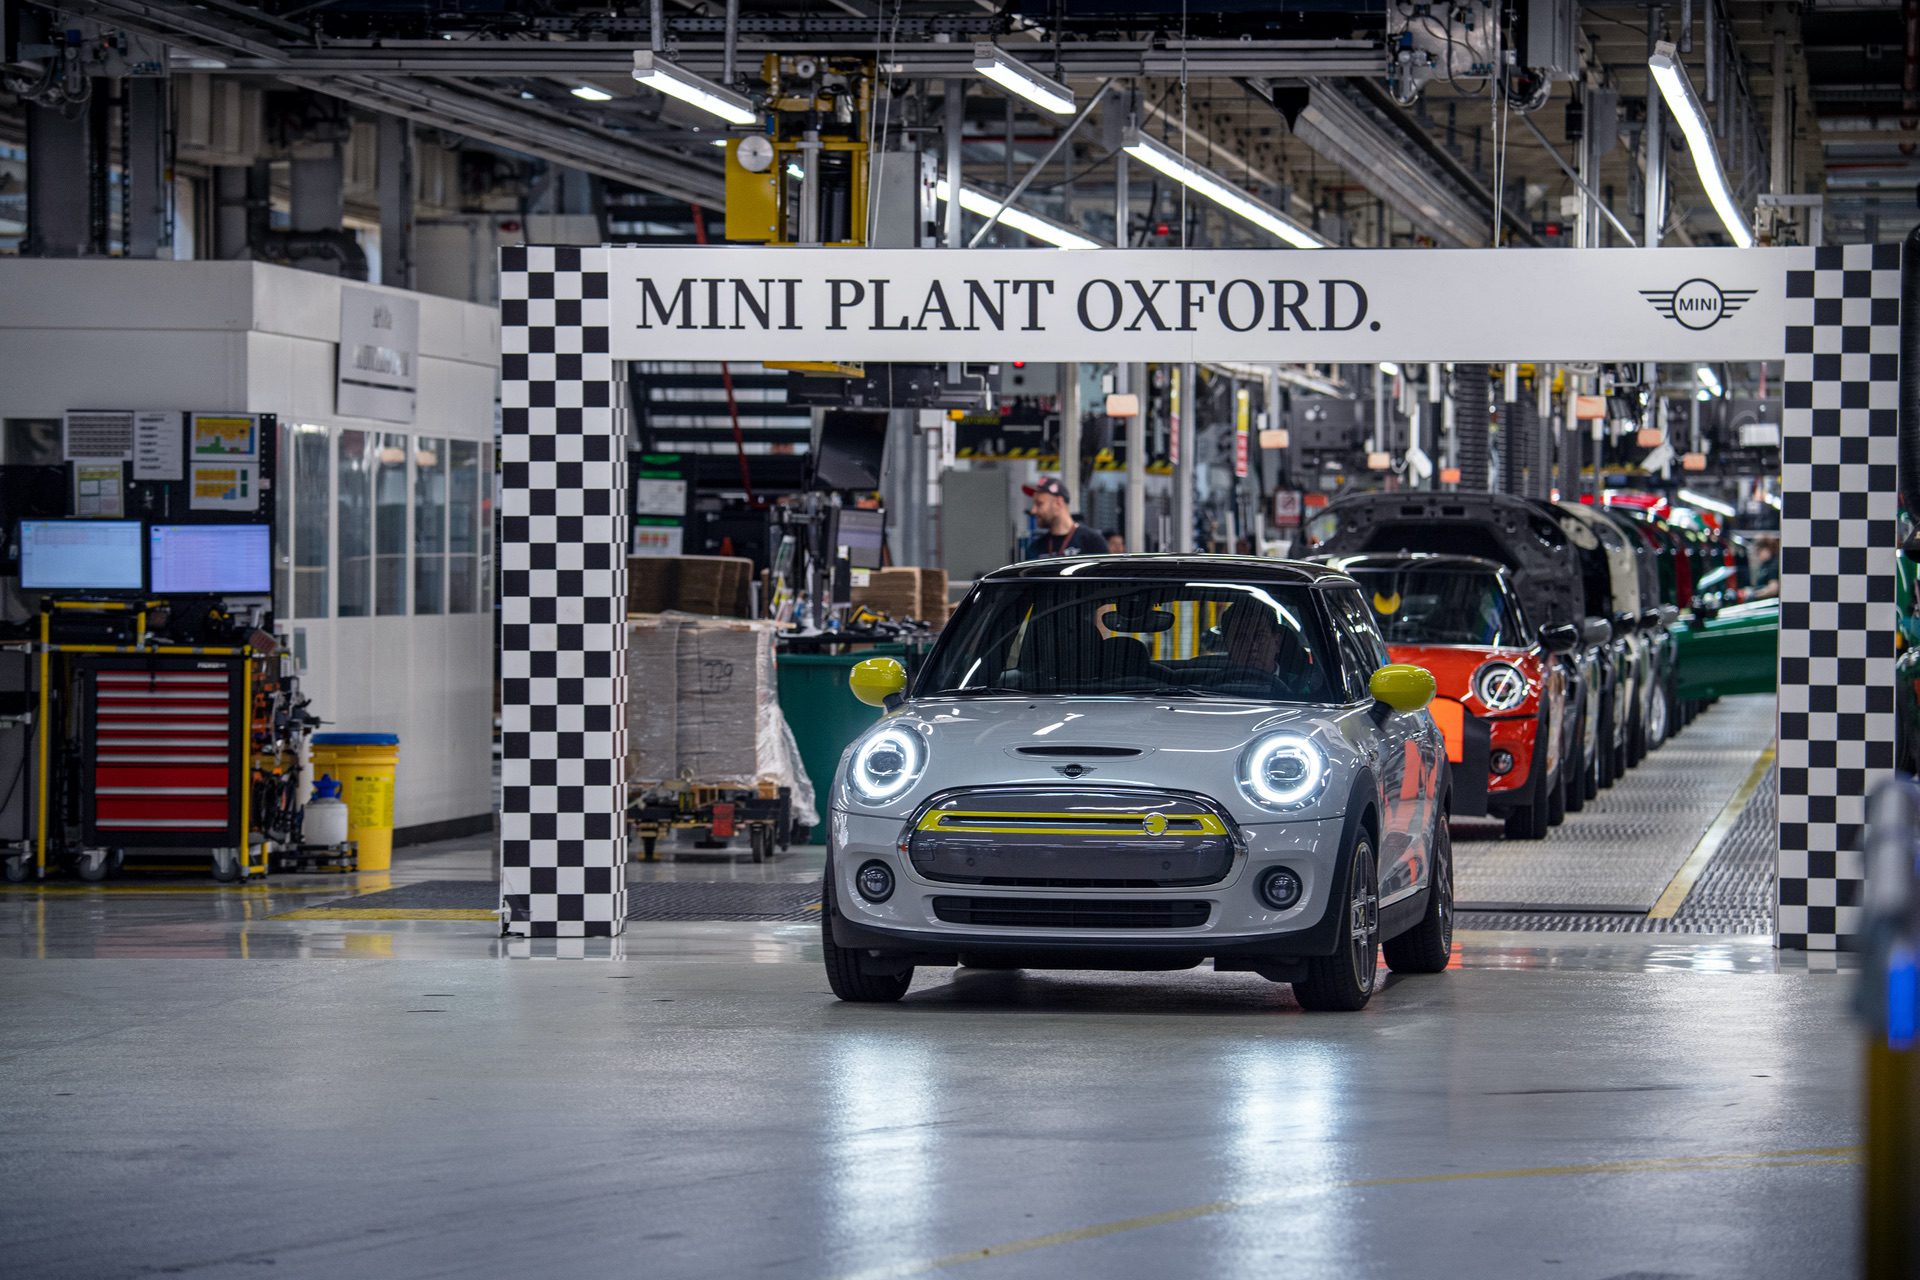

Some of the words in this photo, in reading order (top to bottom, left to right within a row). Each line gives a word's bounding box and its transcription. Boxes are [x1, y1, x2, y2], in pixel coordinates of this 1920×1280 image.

[636, 278, 803, 330] MINI
[826, 279, 1055, 331] PLANT
[1077, 278, 1381, 333] OXFORD.
[1679, 298, 1718, 311] MINI
